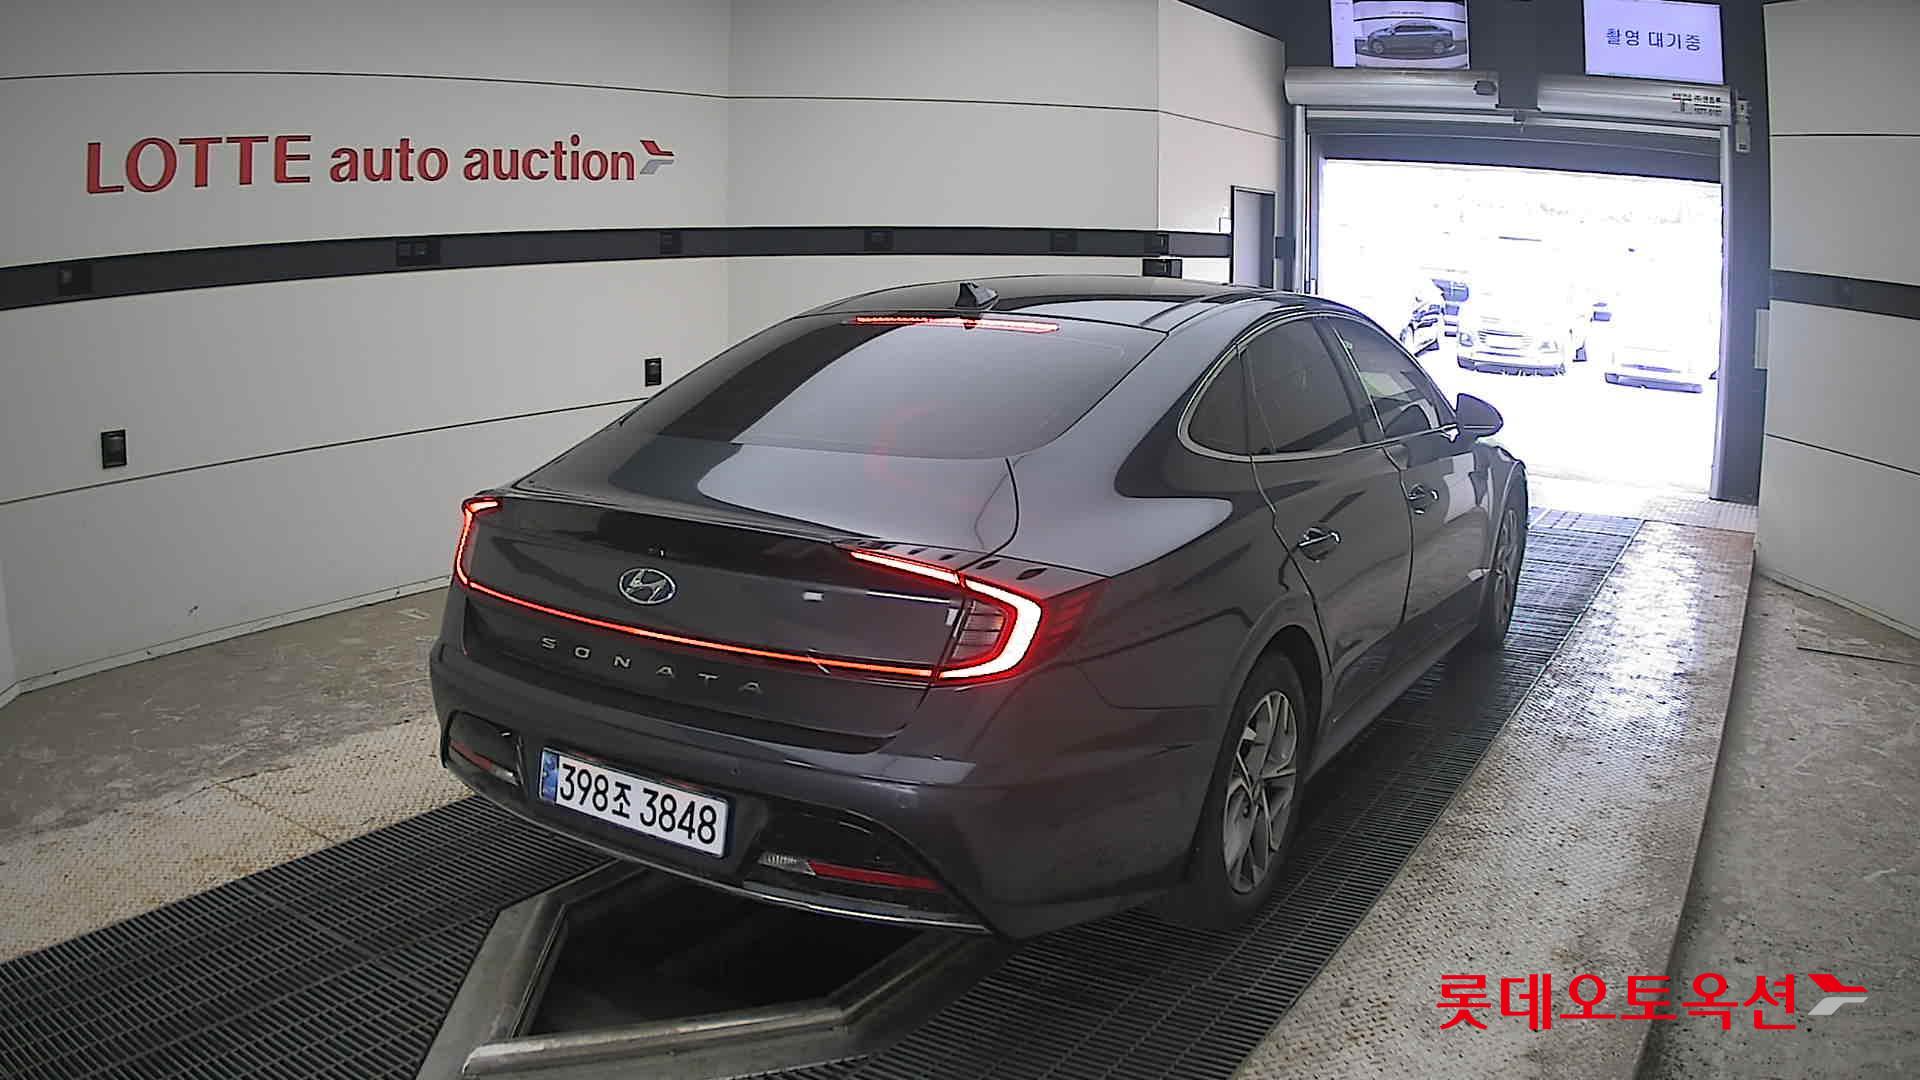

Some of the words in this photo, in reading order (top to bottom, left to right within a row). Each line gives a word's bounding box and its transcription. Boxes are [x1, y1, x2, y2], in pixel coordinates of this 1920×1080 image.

[1648, 31, 1701, 52] 대기중
[87, 135, 312, 194] LOTTE
[329, 138, 449, 182] auto
[463, 134, 635, 181] auction
[541, 636, 763, 695] SONATA
[559, 763, 632, 819] 398조
[639, 788, 717, 845] 3848
